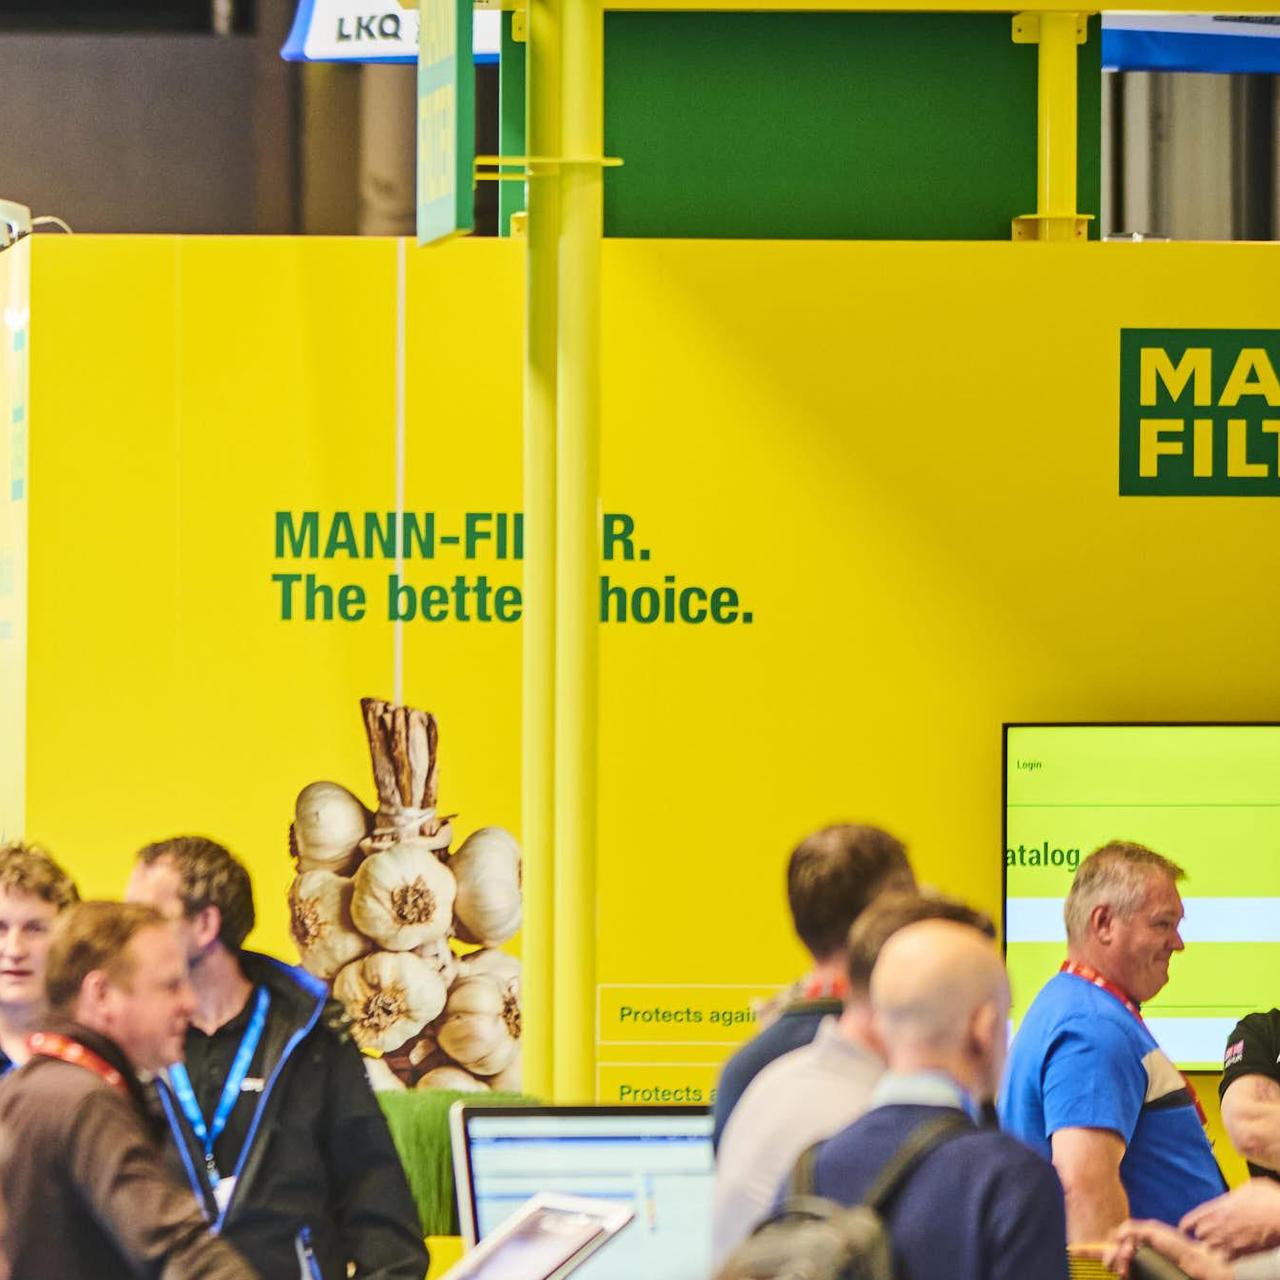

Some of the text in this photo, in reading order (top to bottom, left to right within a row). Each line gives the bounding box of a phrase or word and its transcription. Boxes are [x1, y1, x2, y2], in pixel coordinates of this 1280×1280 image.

[336, 14, 401, 41] LKQ
[1140, 347, 1280, 406] MA
[1139, 418, 1280, 477] FIL
[274, 511, 652, 561] MANN-FIR.
[271, 573, 754, 625] The bette hoice.
[1016, 759, 1042, 771] Login
[1007, 841, 1081, 873] atalog
[620, 1006, 757, 1027] Protects agai
[619, 1085, 703, 1102] Protects
